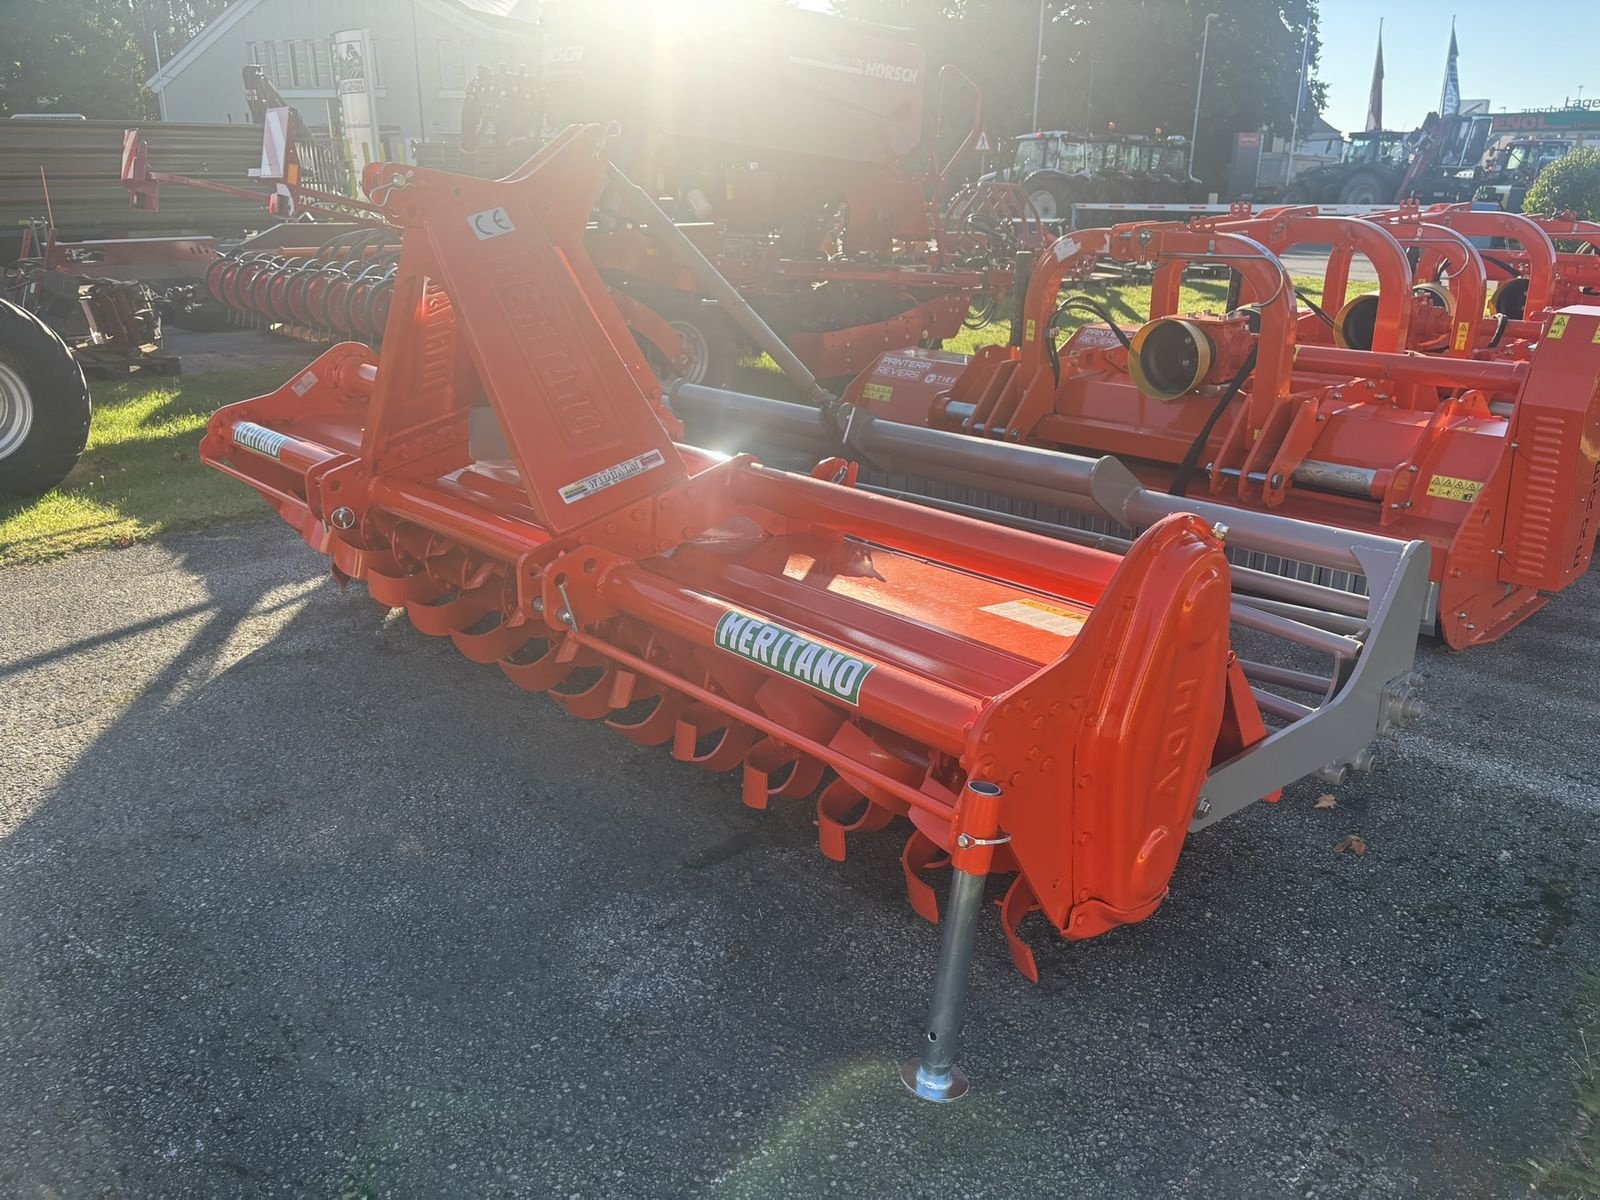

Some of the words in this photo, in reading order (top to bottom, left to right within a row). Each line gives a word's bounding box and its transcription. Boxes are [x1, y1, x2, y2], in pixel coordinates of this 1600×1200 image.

[865, 62, 918, 84] HORSCH
[874, 365, 922, 381] REVERS
[880, 355, 933, 371] PANTERA
[234, 422, 287, 457] MERITANO
[720, 611, 864, 697] MERITANO
